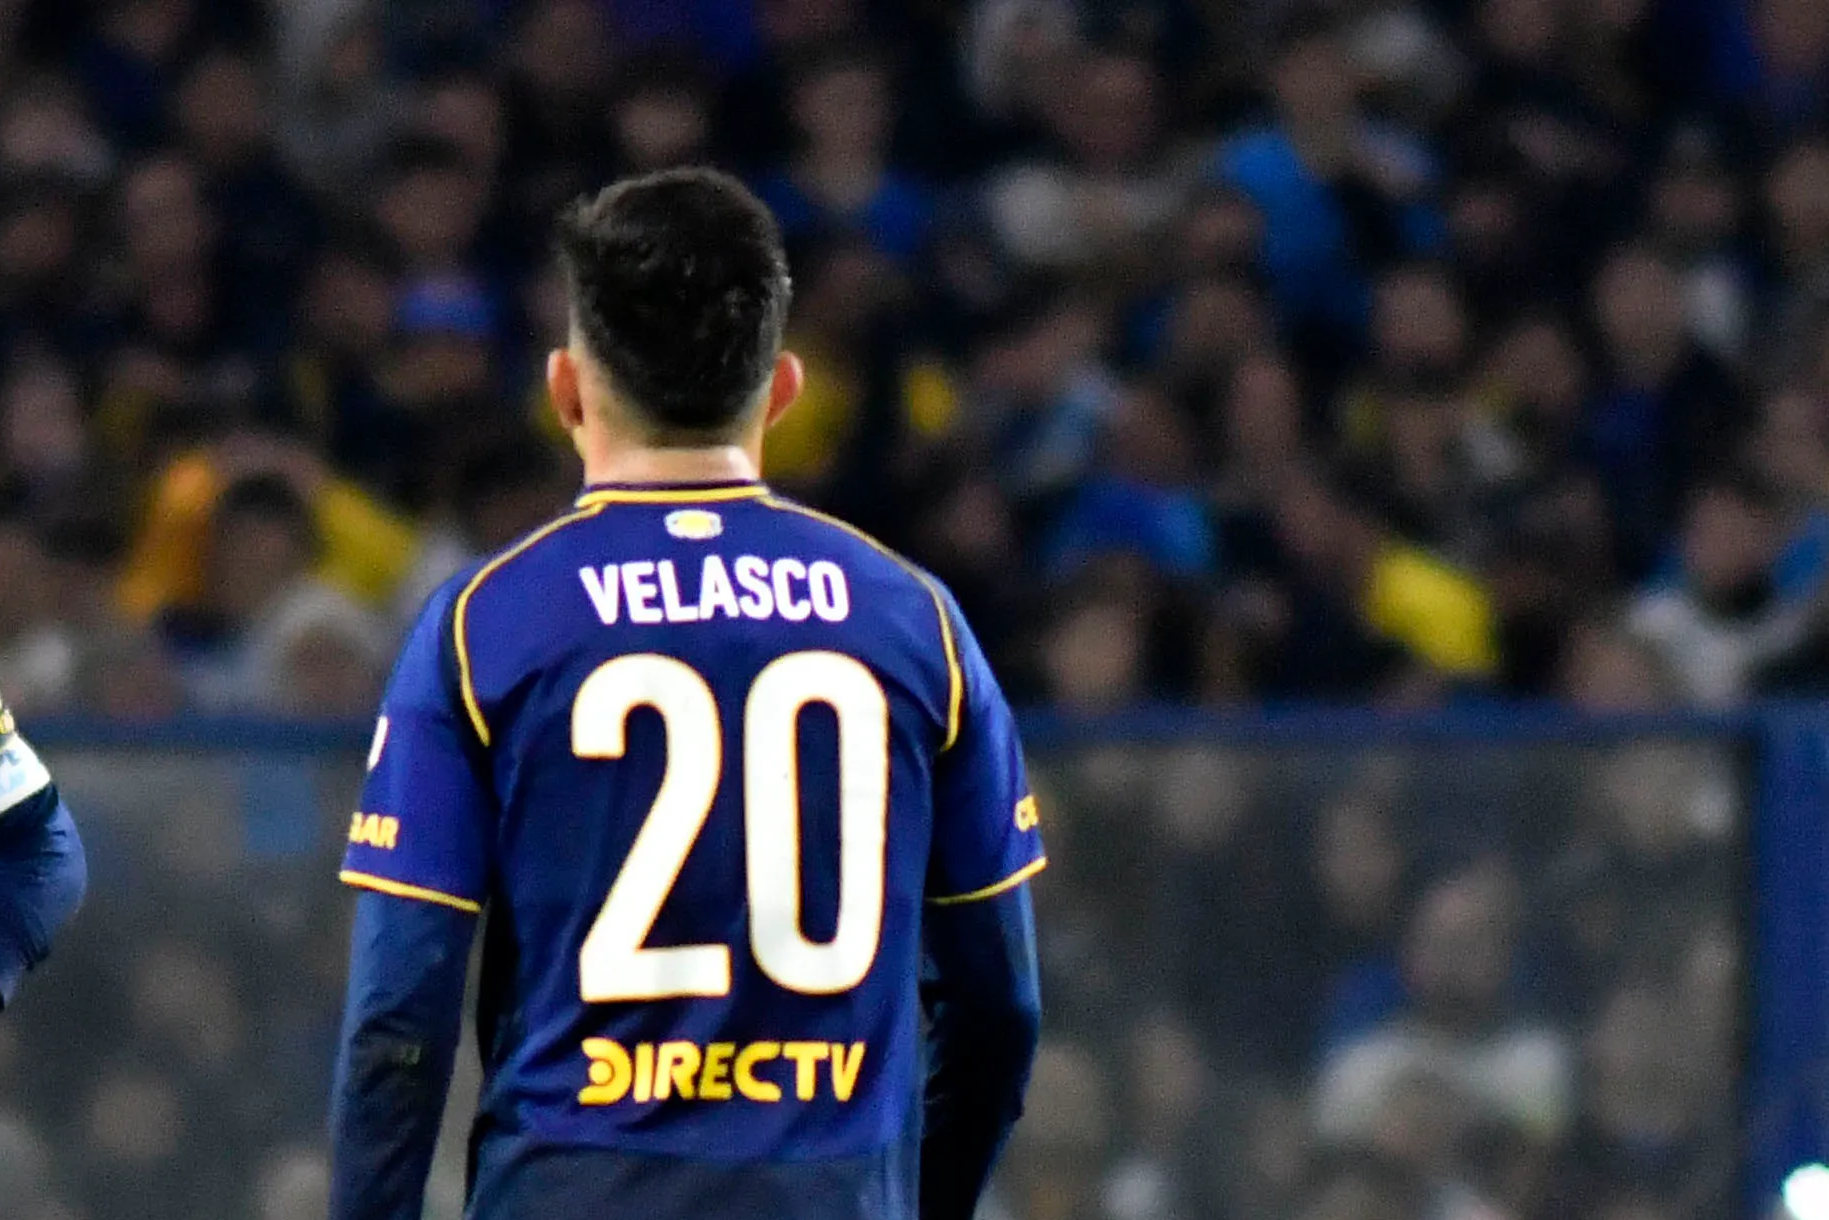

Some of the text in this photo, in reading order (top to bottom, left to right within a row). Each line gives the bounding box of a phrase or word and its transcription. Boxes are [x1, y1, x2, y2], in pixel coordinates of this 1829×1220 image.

[578, 553, 850, 626] VELASCO
[571, 649, 888, 1002] 20
[577, 1036, 866, 1105] DIRECTV
